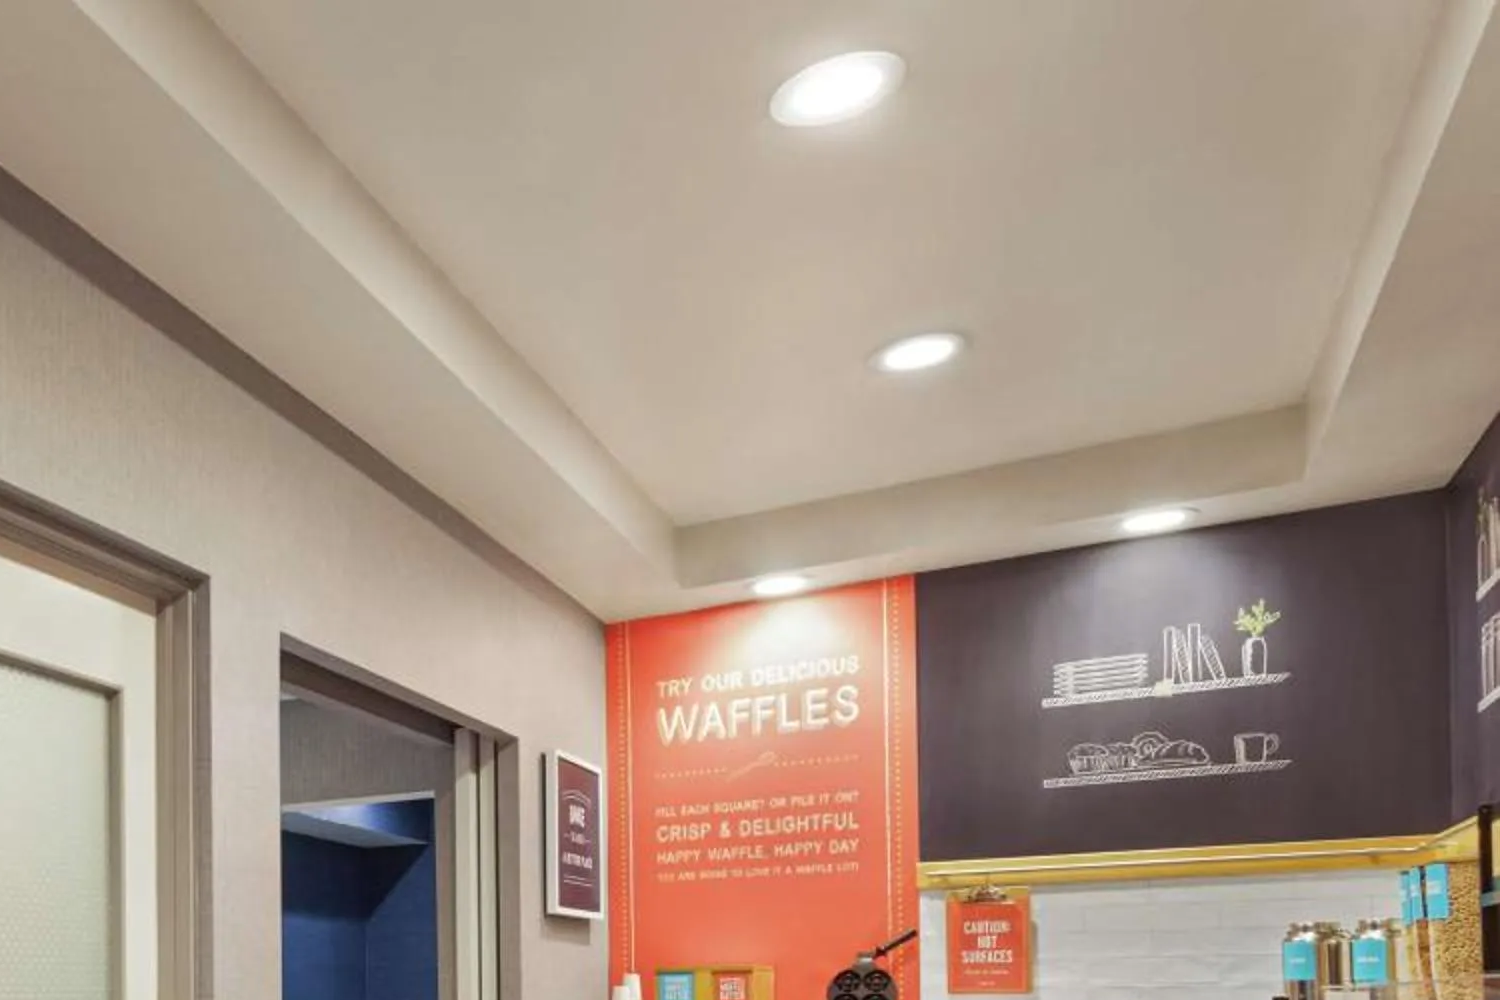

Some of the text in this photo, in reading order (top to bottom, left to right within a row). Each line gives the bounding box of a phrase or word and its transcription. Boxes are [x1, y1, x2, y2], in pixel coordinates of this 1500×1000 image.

[656, 655, 860, 698] TRY OUR DELICIOUS
[657, 685, 860, 747] WAFFLES
[657, 811, 860, 842] CRISP & DELIGHTFUL
[656, 848, 701, 865] HAPPY
[773, 841, 823, 858] HAPPY
[829, 838, 860, 855] DAY
